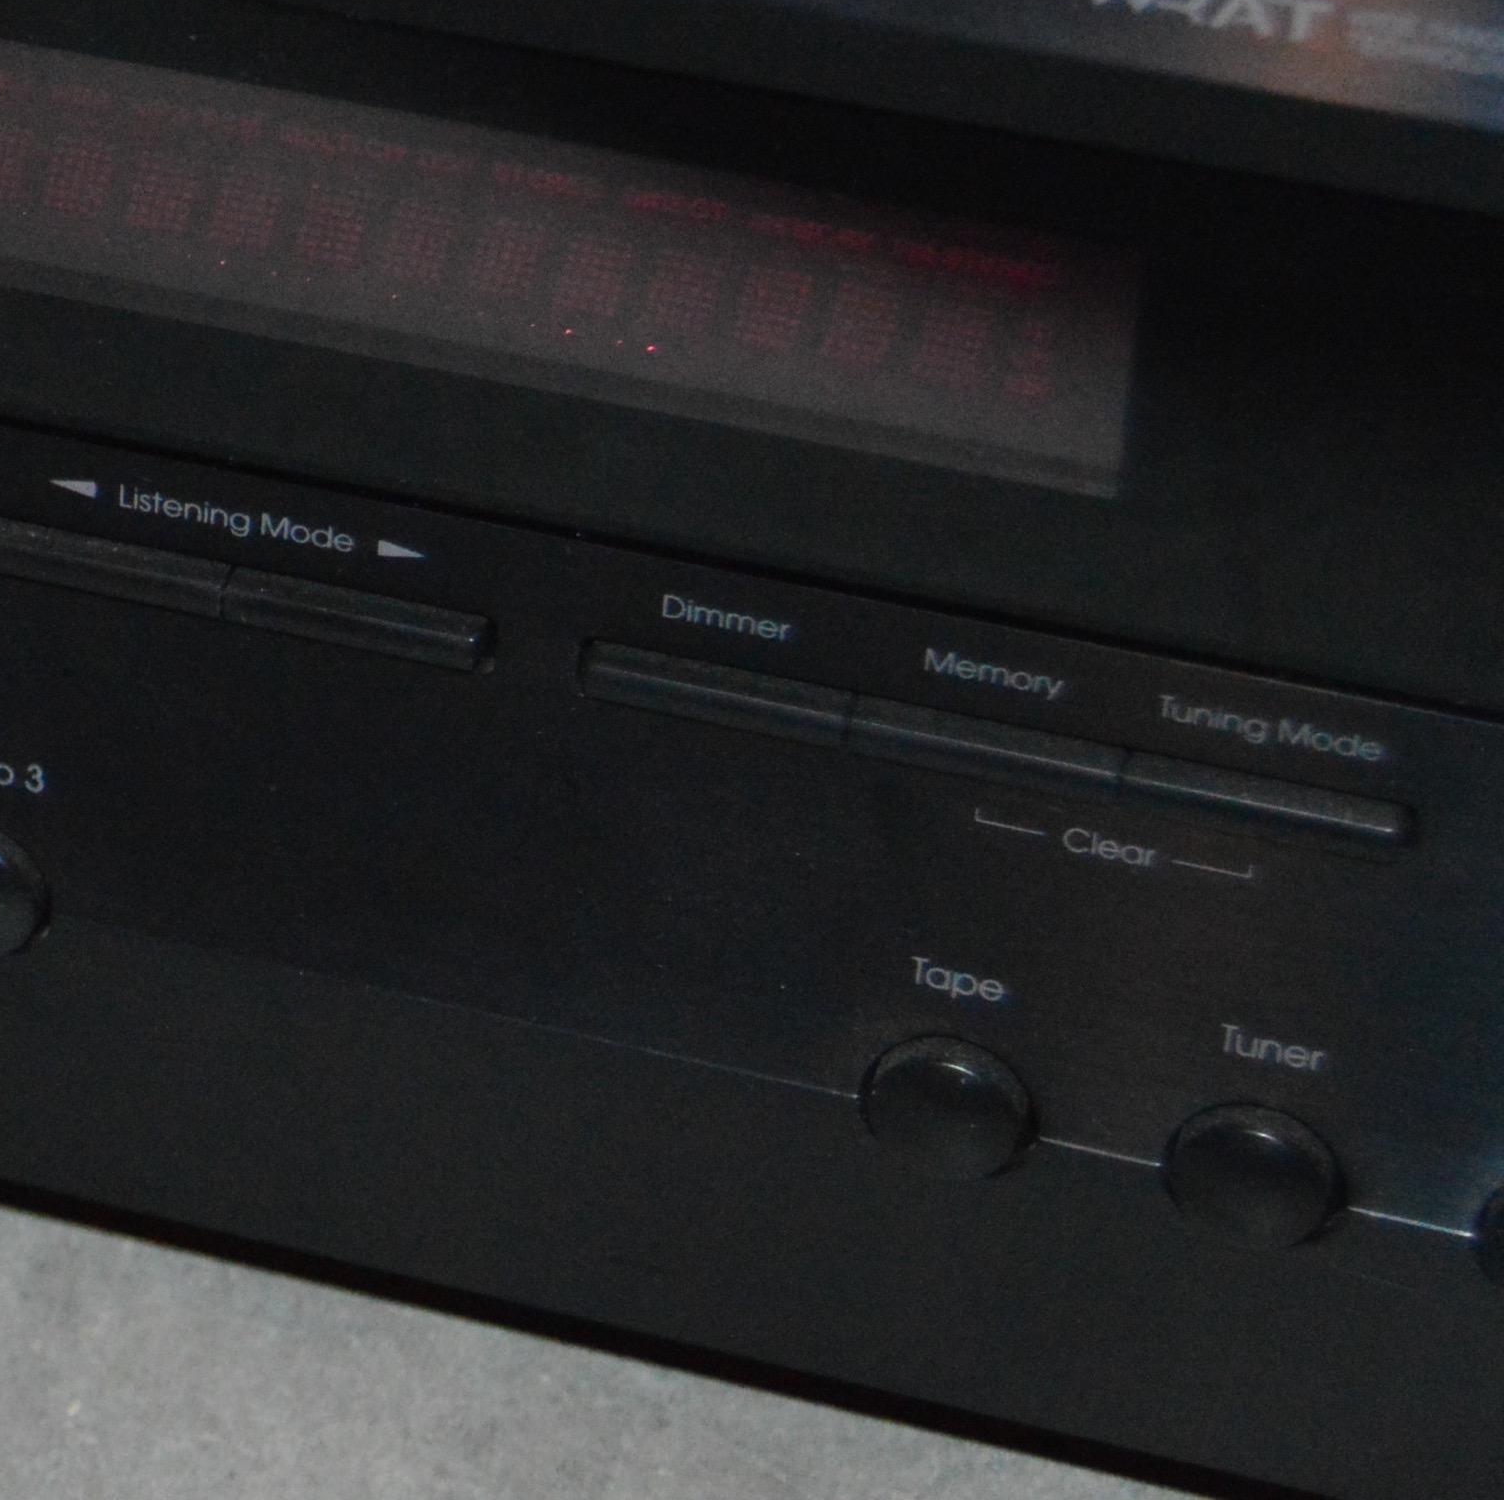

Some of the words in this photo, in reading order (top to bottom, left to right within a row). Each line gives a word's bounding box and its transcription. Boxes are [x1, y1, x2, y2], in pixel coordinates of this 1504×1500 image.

[119, 483, 251, 539] Listening
[260, 511, 356, 555] Mode
[662, 593, 791, 642] Dimmer
[924, 647, 1065, 702] Memory
[1159, 694, 1267, 747] Tuning
[1277, 716, 1386, 764] Mode
[24, 763, 48, 795] 3
[1061, 826, 1157, 870] Clear
[911, 956, 1005, 1003] Tape
[1221, 1024, 1325, 1072] Tuner
